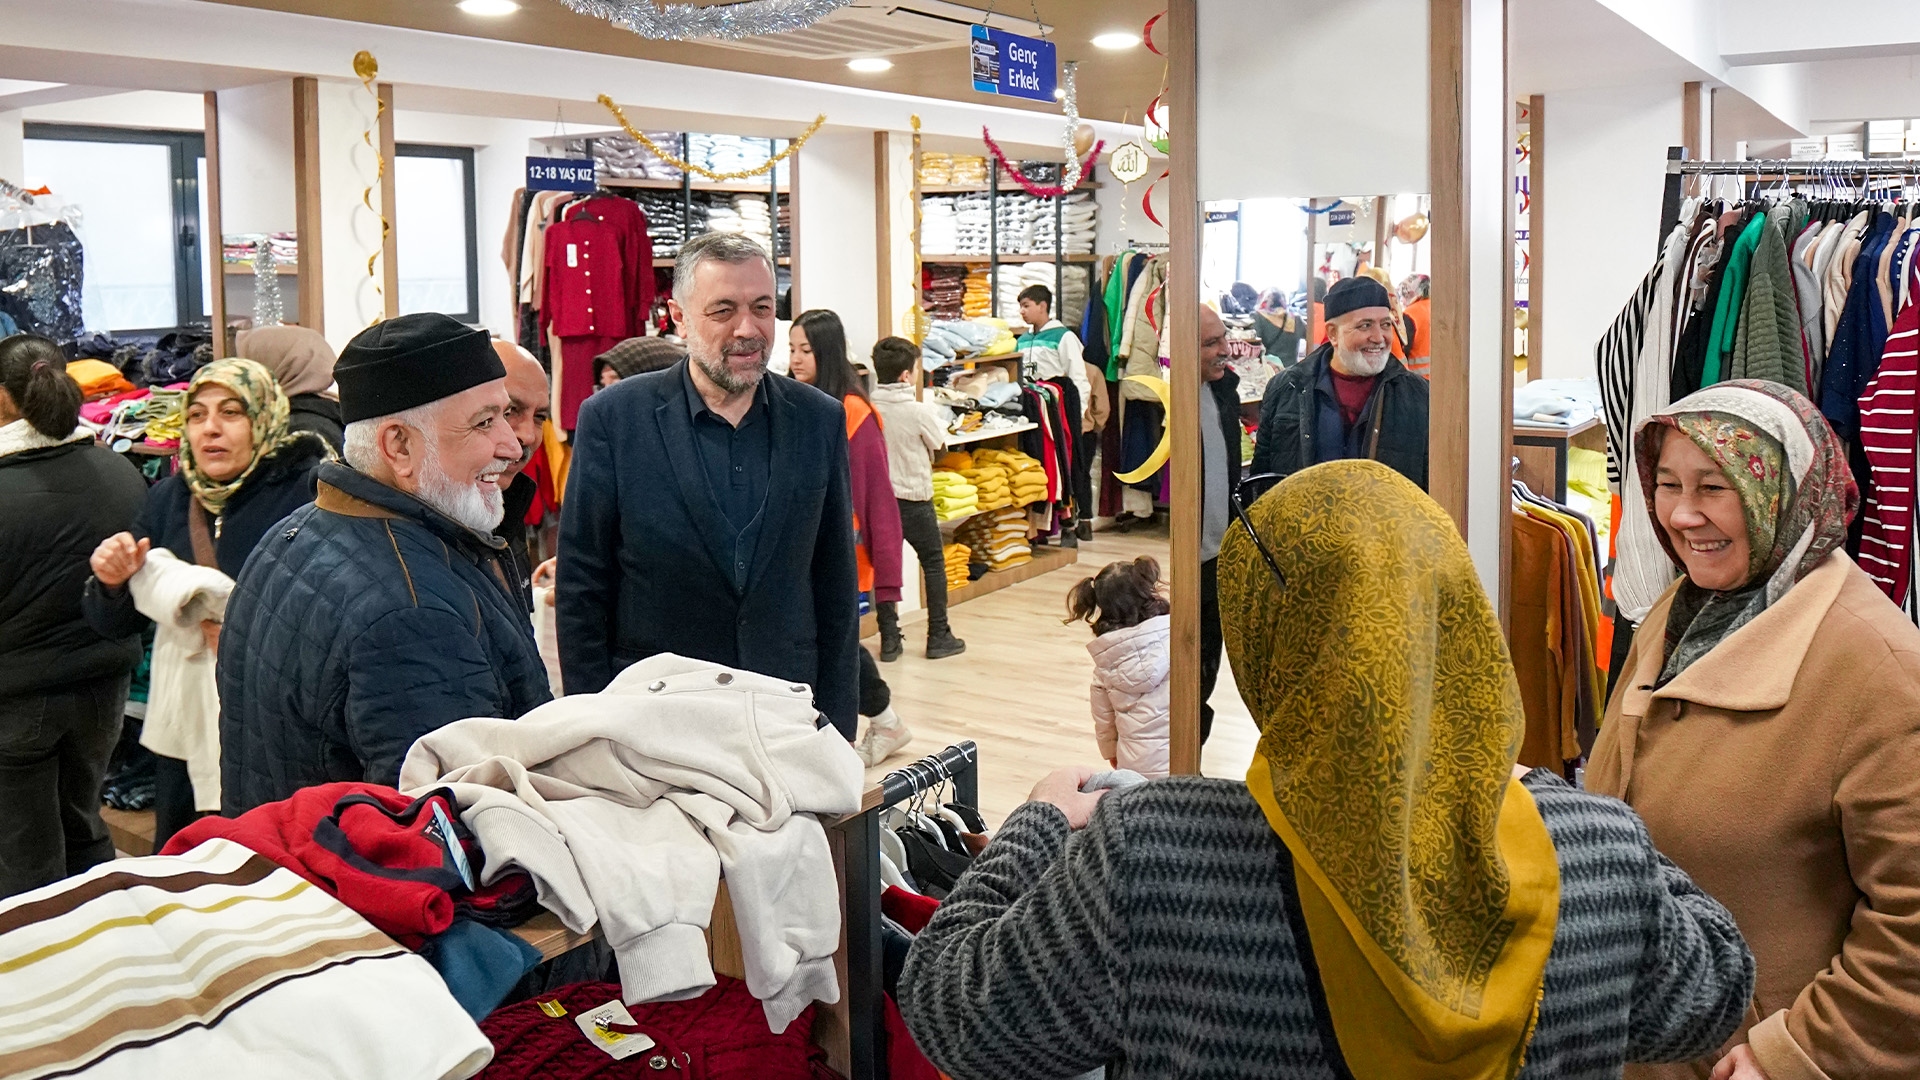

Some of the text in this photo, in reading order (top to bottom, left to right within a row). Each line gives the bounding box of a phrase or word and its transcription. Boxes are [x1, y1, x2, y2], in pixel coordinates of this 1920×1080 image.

[1008, 42, 1037, 69] Genç
[1008, 68, 1040, 91] Erkek
[529, 165, 593, 183] 12-18 YAŞ KIZ
